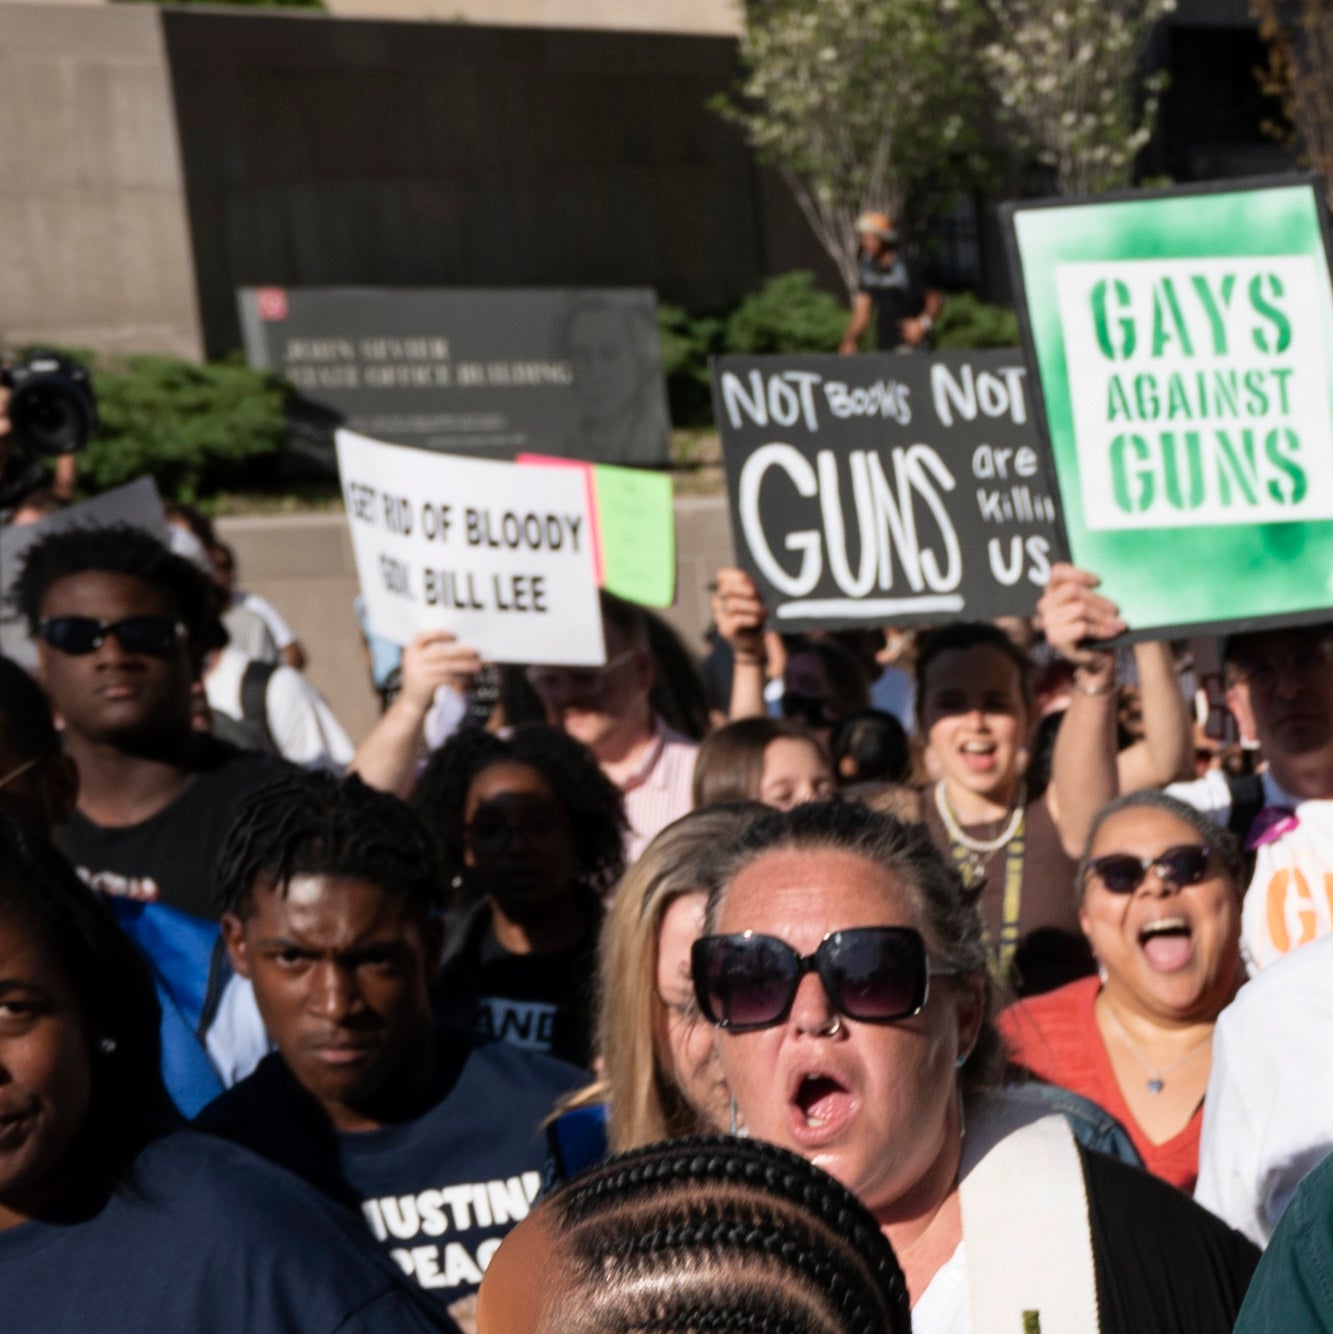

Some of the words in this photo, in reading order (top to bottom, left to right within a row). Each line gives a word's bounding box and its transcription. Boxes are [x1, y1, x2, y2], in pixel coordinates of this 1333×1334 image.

[1090, 272, 1292, 361] GAYS
[721, 368, 822, 433] NOT
[931, 363, 1027, 427] NOT
[1107, 368, 1294, 422] AGAINST
[972, 444, 1038, 479] are
[1109, 427, 1308, 515] GUNS
[383, 492, 413, 537] RID
[422, 503, 452, 542] OF
[465, 507, 581, 552] BLOODY
[739, 442, 963, 598] GUNS
[424, 568, 483, 610] BILL
[493, 574, 548, 613] LEE
